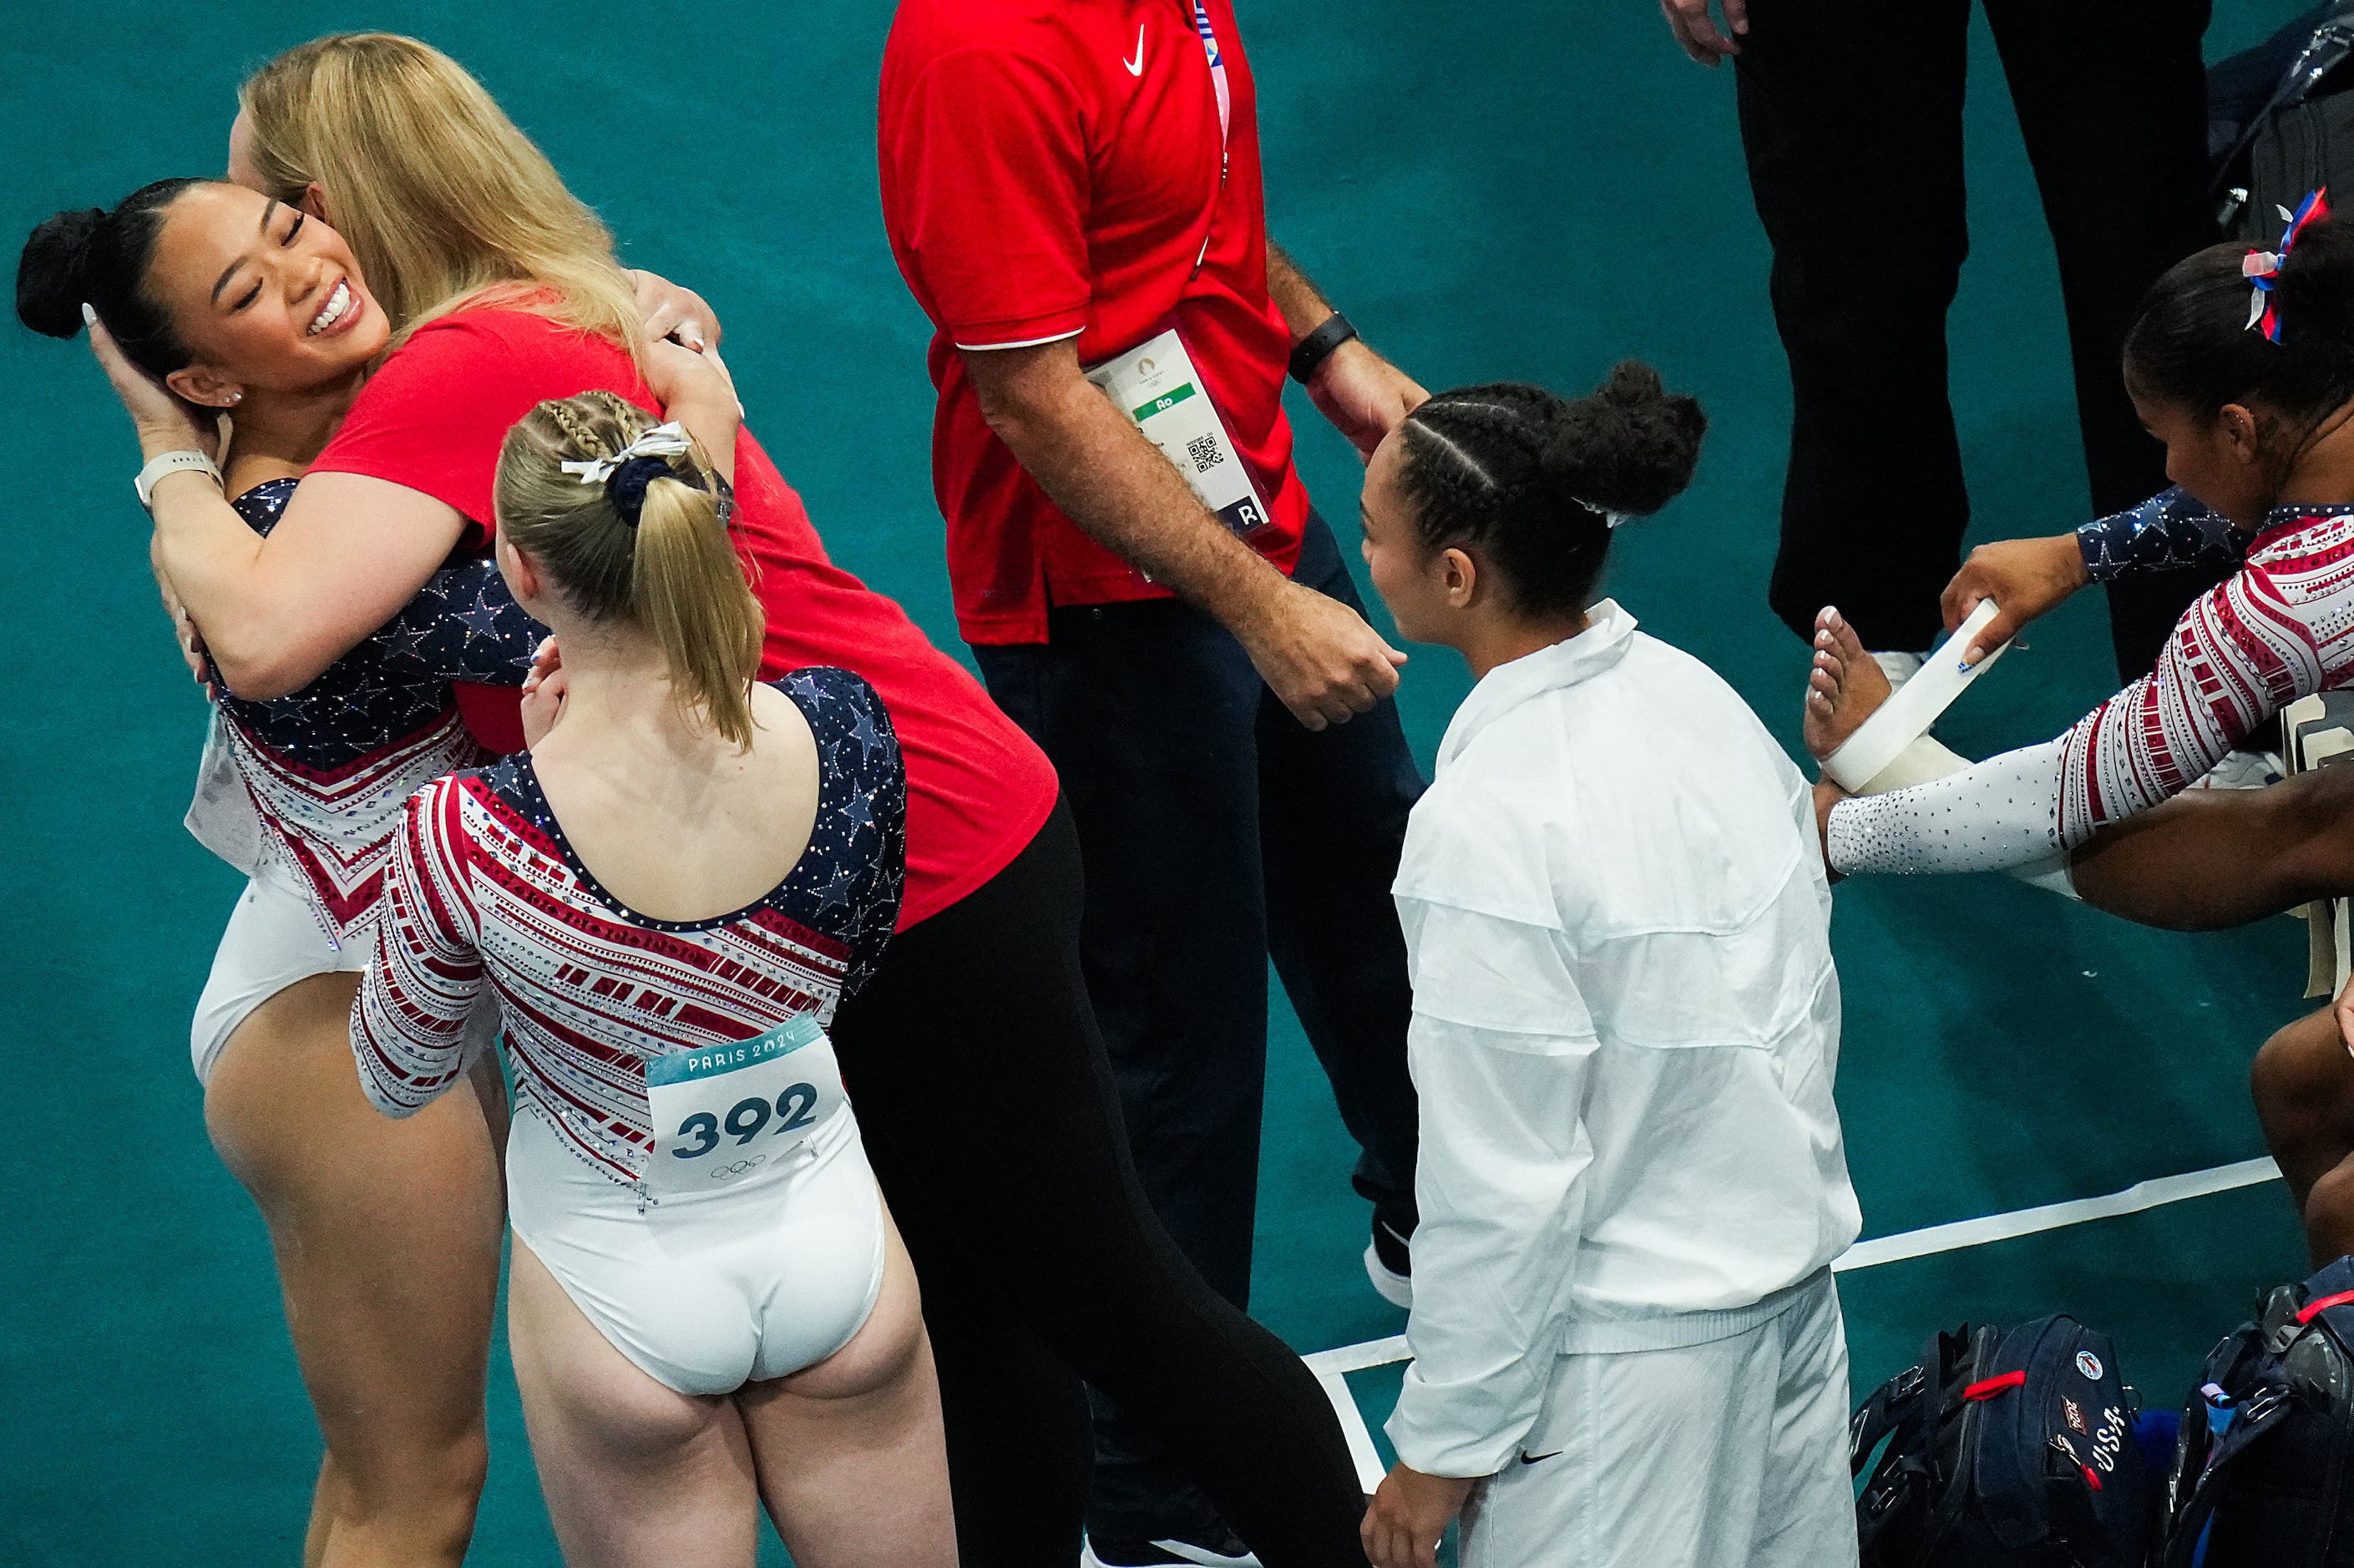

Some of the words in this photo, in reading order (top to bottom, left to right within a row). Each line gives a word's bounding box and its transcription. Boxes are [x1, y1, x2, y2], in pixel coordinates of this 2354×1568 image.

[1238, 505, 1258, 525] R
[688, 1049, 746, 1072] PARIS
[752, 1031, 796, 1057] 2024
[671, 1082, 818, 1159] 392
[2065, 1398, 2083, 1429] 2024
[2092, 1408, 2125, 1472] USA
